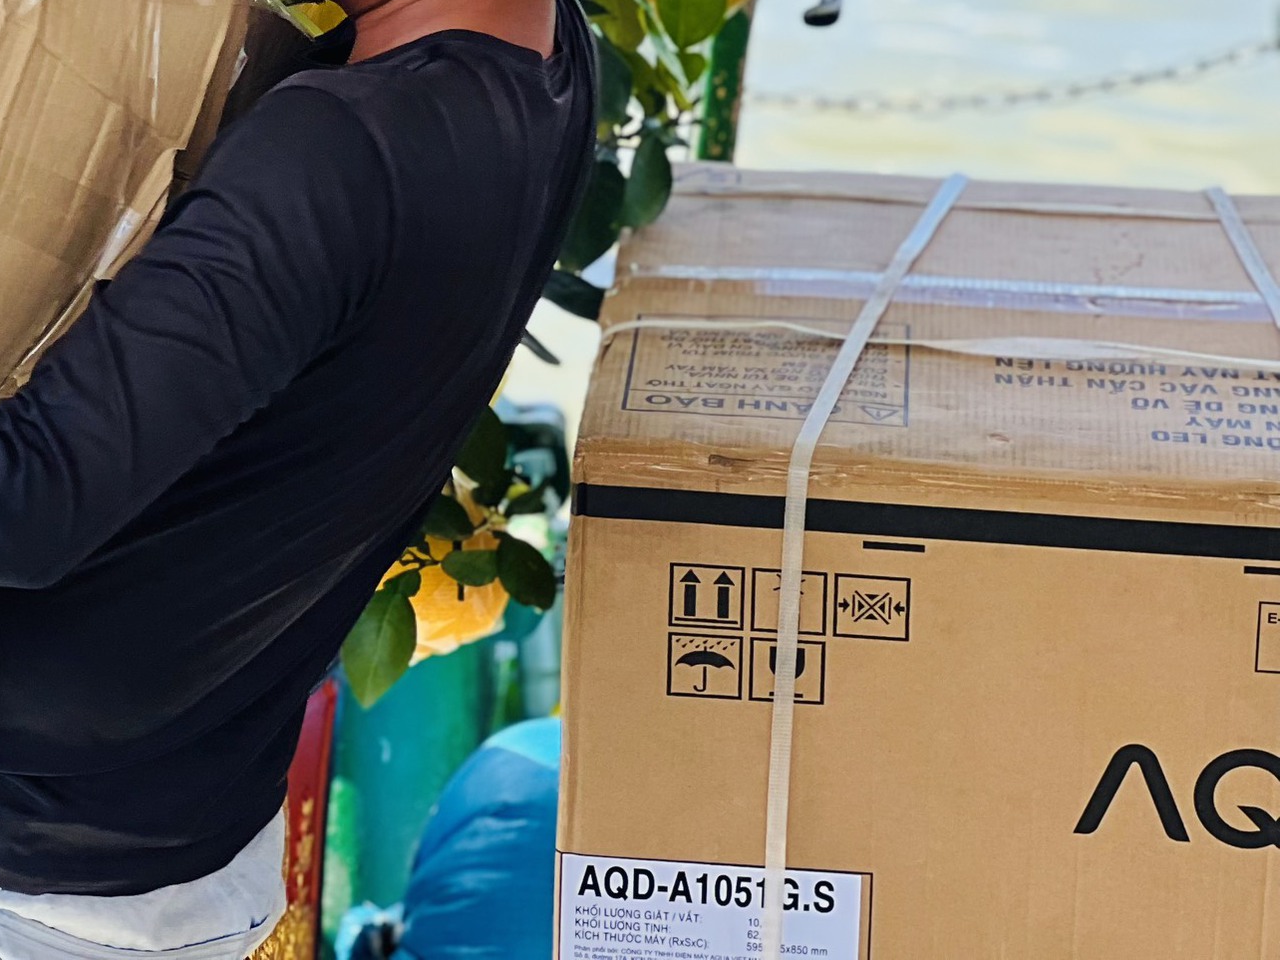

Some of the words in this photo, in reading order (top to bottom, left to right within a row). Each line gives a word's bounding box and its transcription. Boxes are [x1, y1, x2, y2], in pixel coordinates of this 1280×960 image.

[1160, 382, 1218, 396] VÁC
[1151, 430, 1207, 444] LEO
[1222, 434, 1280, 451] ÔNG
[578, 865, 835, 914] AQD-A1051G.S
[575, 904, 601, 916] KHỐI
[575, 916, 601, 928] KHỐI
[574, 929, 600, 940] KÍCH
[644, 934, 666, 946] MÁY
[810, 947, 828, 956] mm
